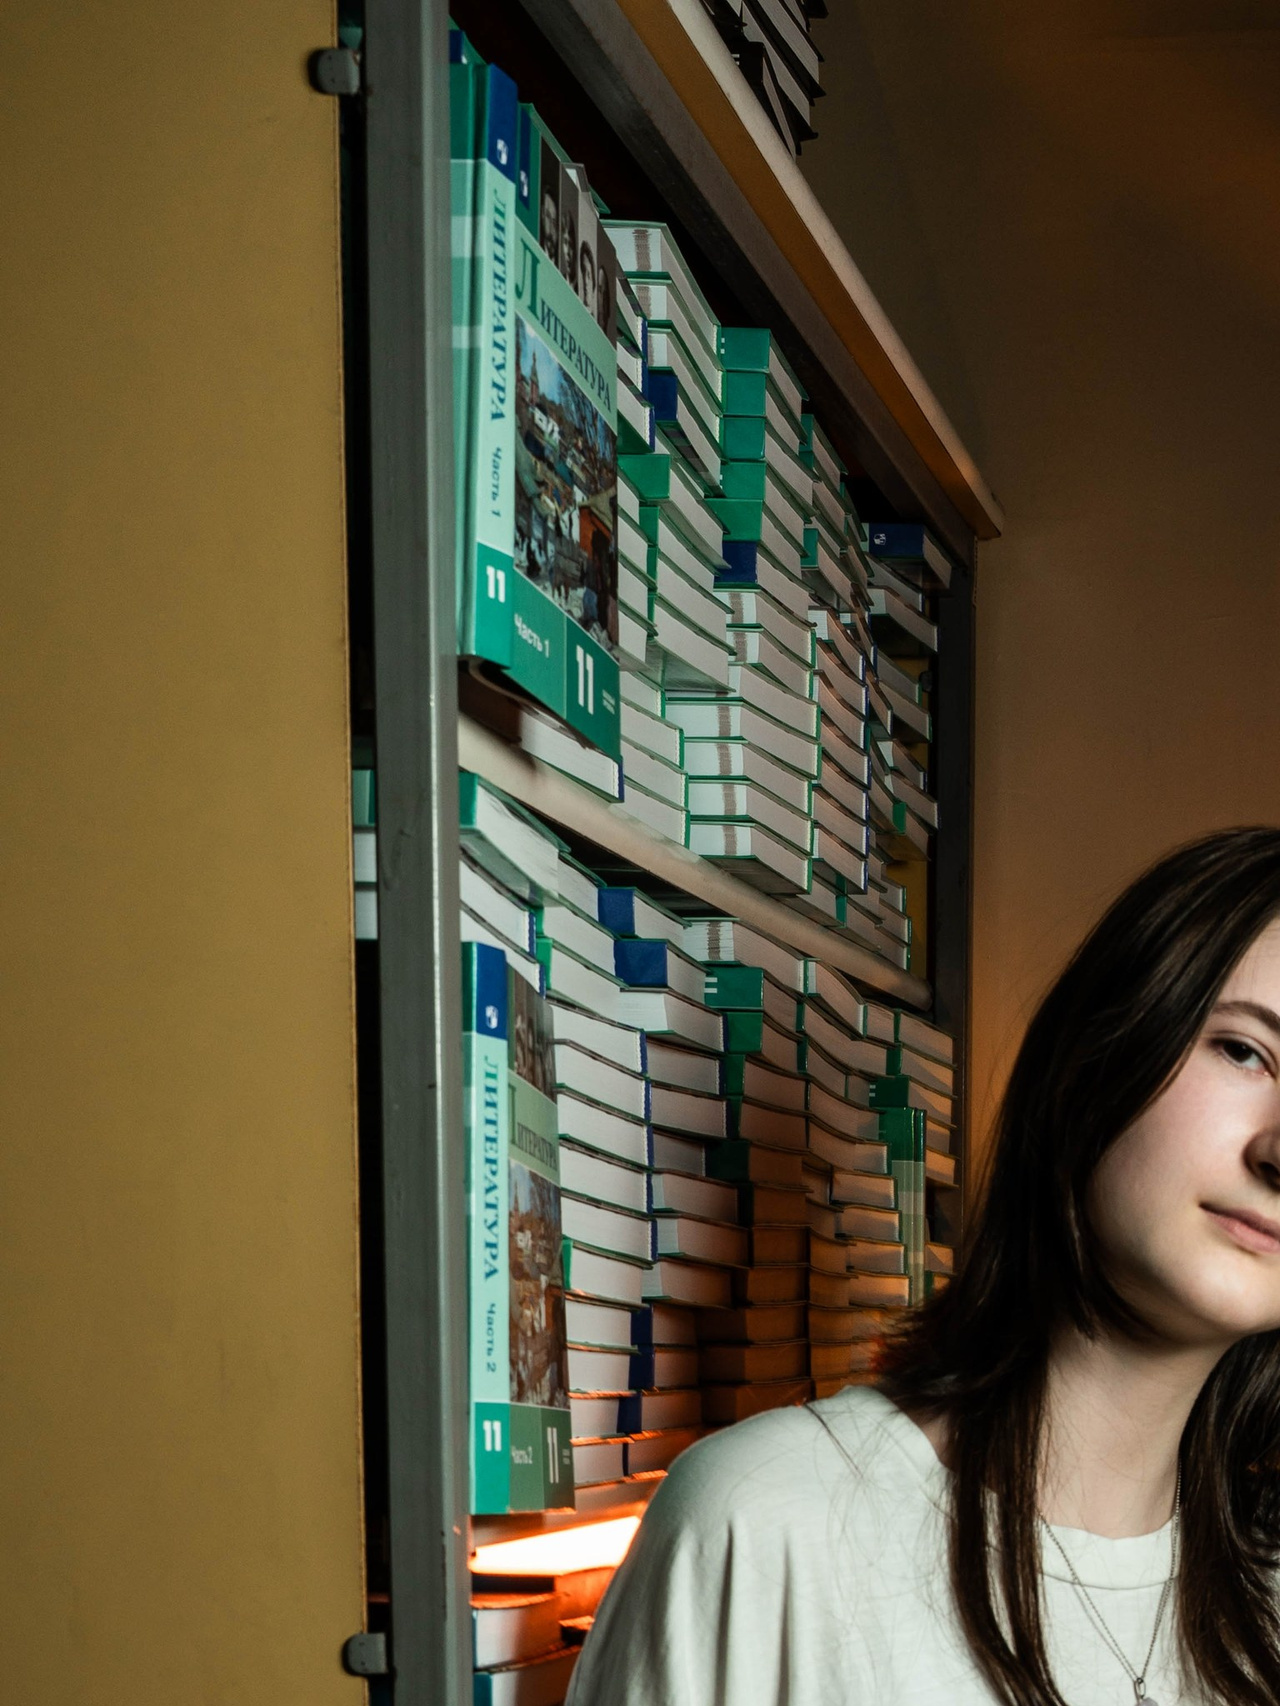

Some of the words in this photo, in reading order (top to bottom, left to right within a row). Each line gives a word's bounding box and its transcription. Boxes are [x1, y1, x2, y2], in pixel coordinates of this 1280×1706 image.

[490, 189, 508, 421] ЛИТЕРАТУРА
[515, 238, 612, 413] ЛИТЕРАТУРА
[490, 446, 503, 501] Часть
[485, 564, 506, 604] 11
[575, 644, 596, 716] 11
[484, 1056, 499, 1280] ЛИТЕРАТУРА
[486, 1303, 496, 1356] Часть
[483, 1420, 502, 1452] 11
[546, 1426, 560, 1484] 11
